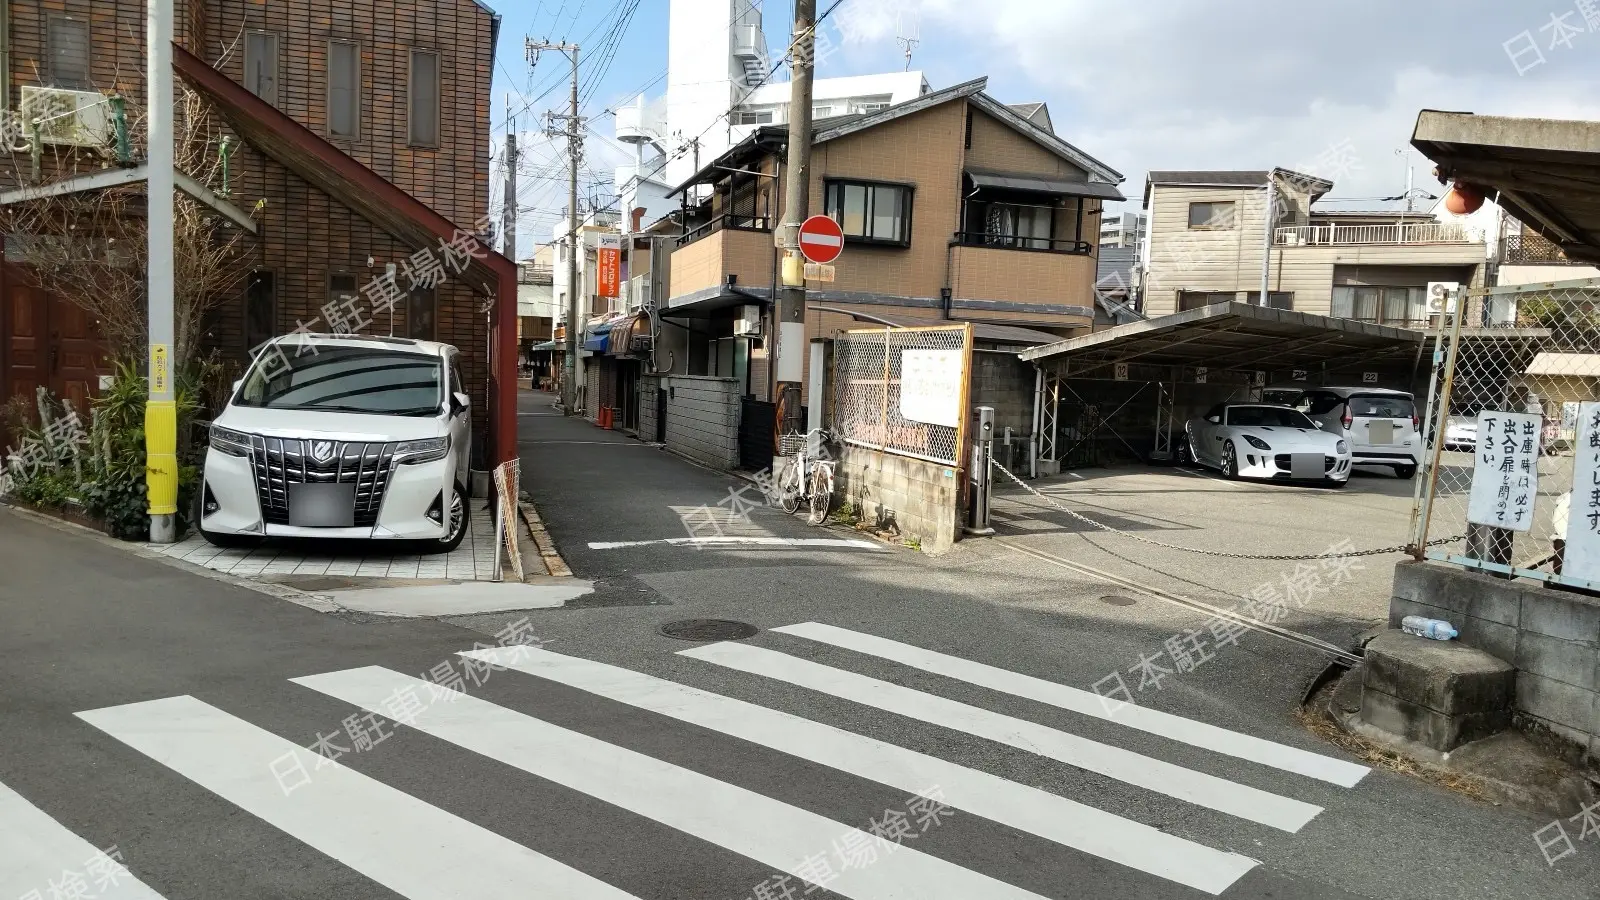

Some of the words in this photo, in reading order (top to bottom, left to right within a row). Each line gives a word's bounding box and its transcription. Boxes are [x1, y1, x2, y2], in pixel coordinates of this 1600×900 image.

[1365, 373, 1376, 381] 22
[1495, 418, 1519, 522] 出入口扉を閉めて
[1513, 420, 1535, 523] 出庫時は必ず
